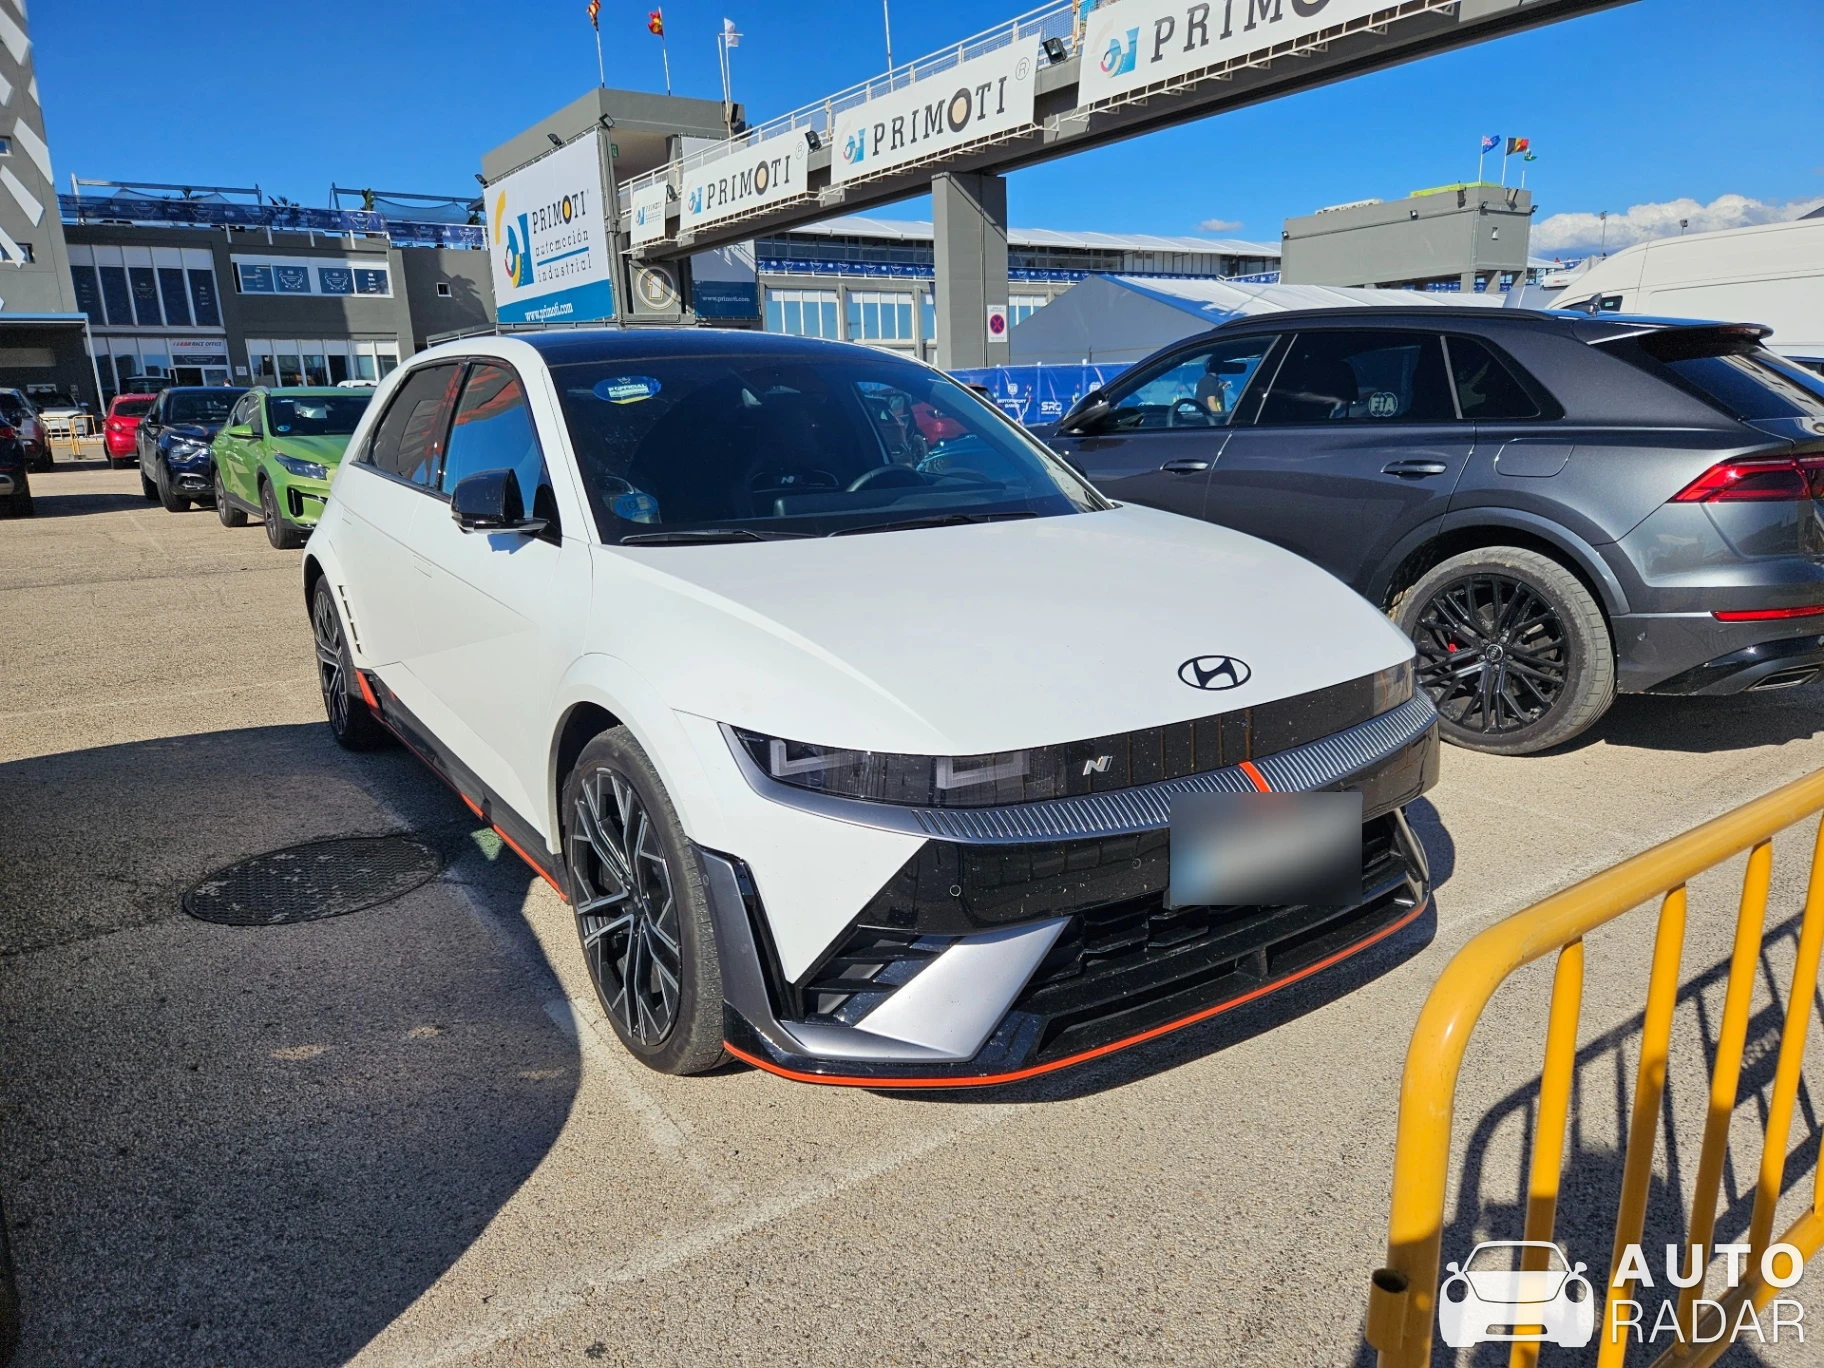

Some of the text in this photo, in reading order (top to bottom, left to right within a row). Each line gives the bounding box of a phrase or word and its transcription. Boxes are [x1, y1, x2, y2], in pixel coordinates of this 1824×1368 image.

[872, 76, 1007, 157] PRIMOTI
[706, 155, 791, 210] PRIMOTI
[532, 191, 586, 235] PRIMOTI
[538, 253, 591, 283] industrial
